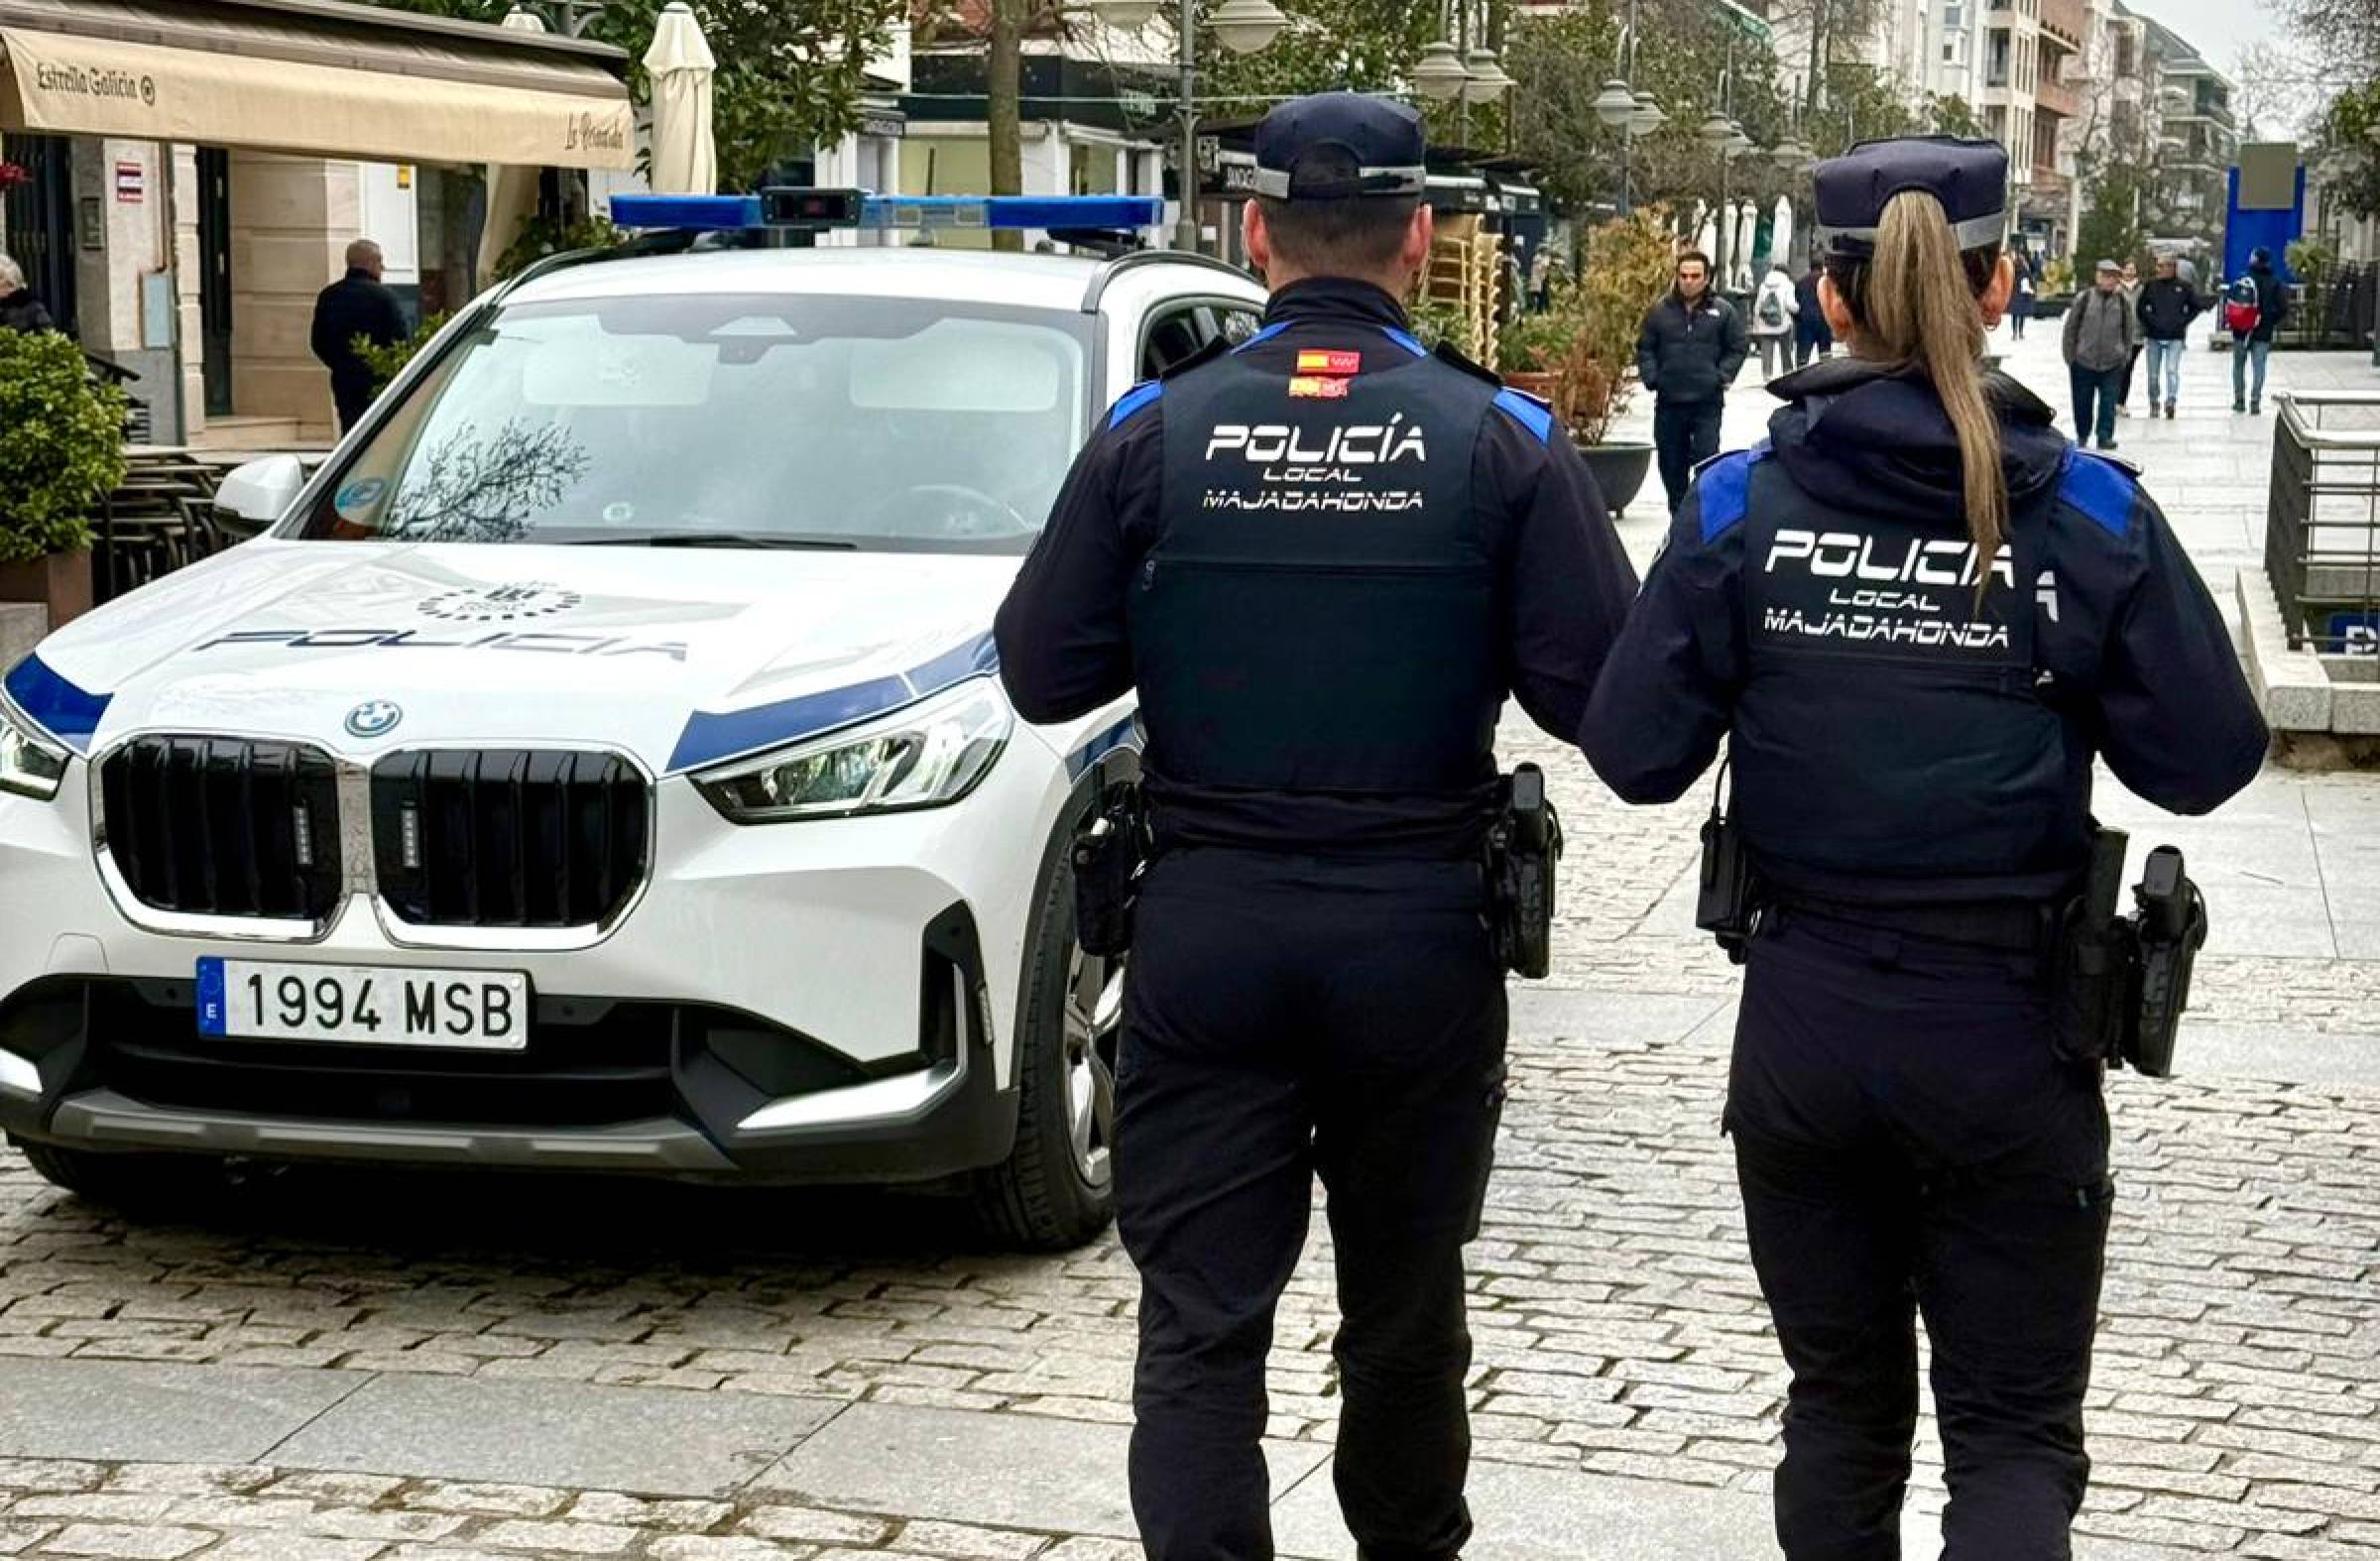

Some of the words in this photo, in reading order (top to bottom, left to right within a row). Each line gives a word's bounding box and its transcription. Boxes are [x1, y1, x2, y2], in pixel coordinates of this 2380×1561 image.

[1205, 412, 1426, 463] POLICÍA
[1262, 467, 1363, 482] LOCAL
[1203, 490, 1423, 511] MAJADAHONDA
[1830, 588, 1940, 611] LOCAL
[1764, 607, 2008, 648] MAJADAHONDA
[192, 629, 687, 661] POLICIA
[205, 1004, 217, 1021] E
[248, 973, 381, 1032] 1994
[405, 980, 513, 1037] MSB
